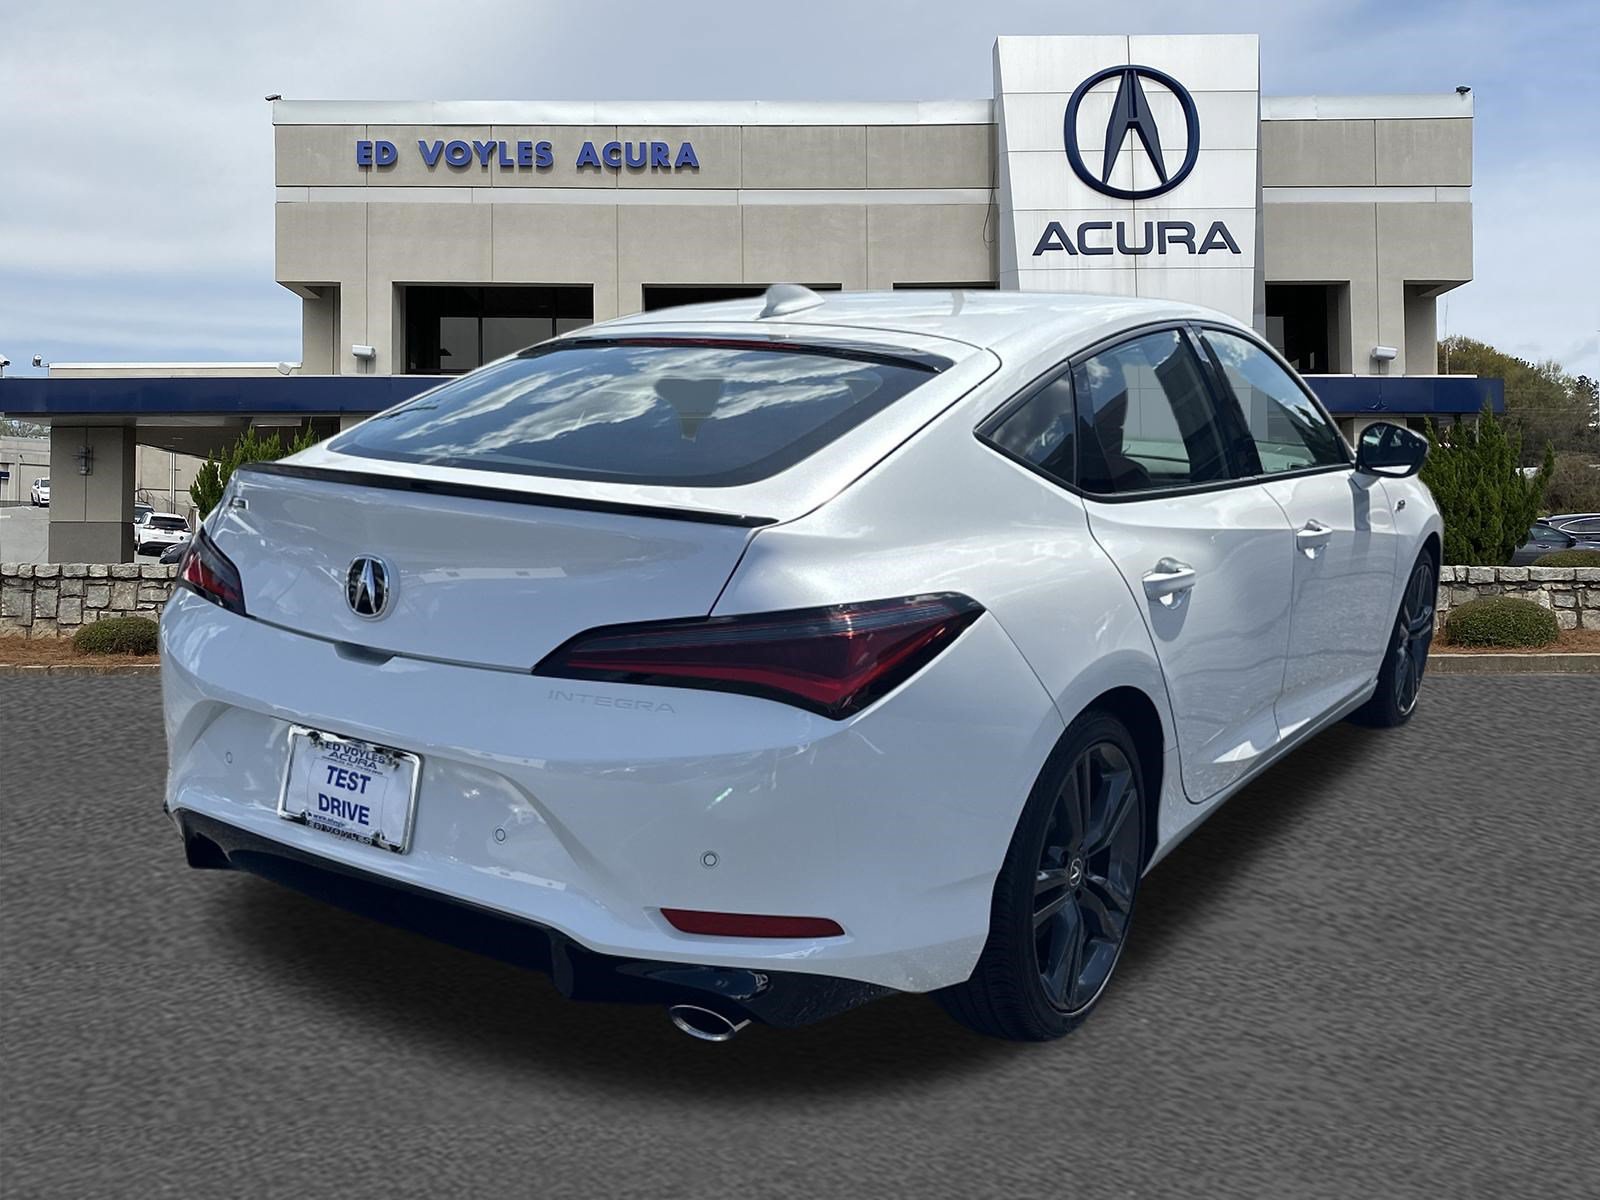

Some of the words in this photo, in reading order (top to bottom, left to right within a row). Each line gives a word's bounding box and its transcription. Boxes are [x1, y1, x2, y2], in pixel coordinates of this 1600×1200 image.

[356, 140, 398, 167] ED
[418, 140, 554, 168] VOYLES
[576, 141, 700, 169] ACURA
[1032, 221, 1242, 256] ACURA
[548, 690, 676, 714] INTEGRA
[325, 741, 341, 752] ED
[343, 745, 386, 765] VOYLES
[328, 751, 378, 770] ACURA
[326, 765, 372, 794] TEST
[318, 793, 370, 826] DRIVE
